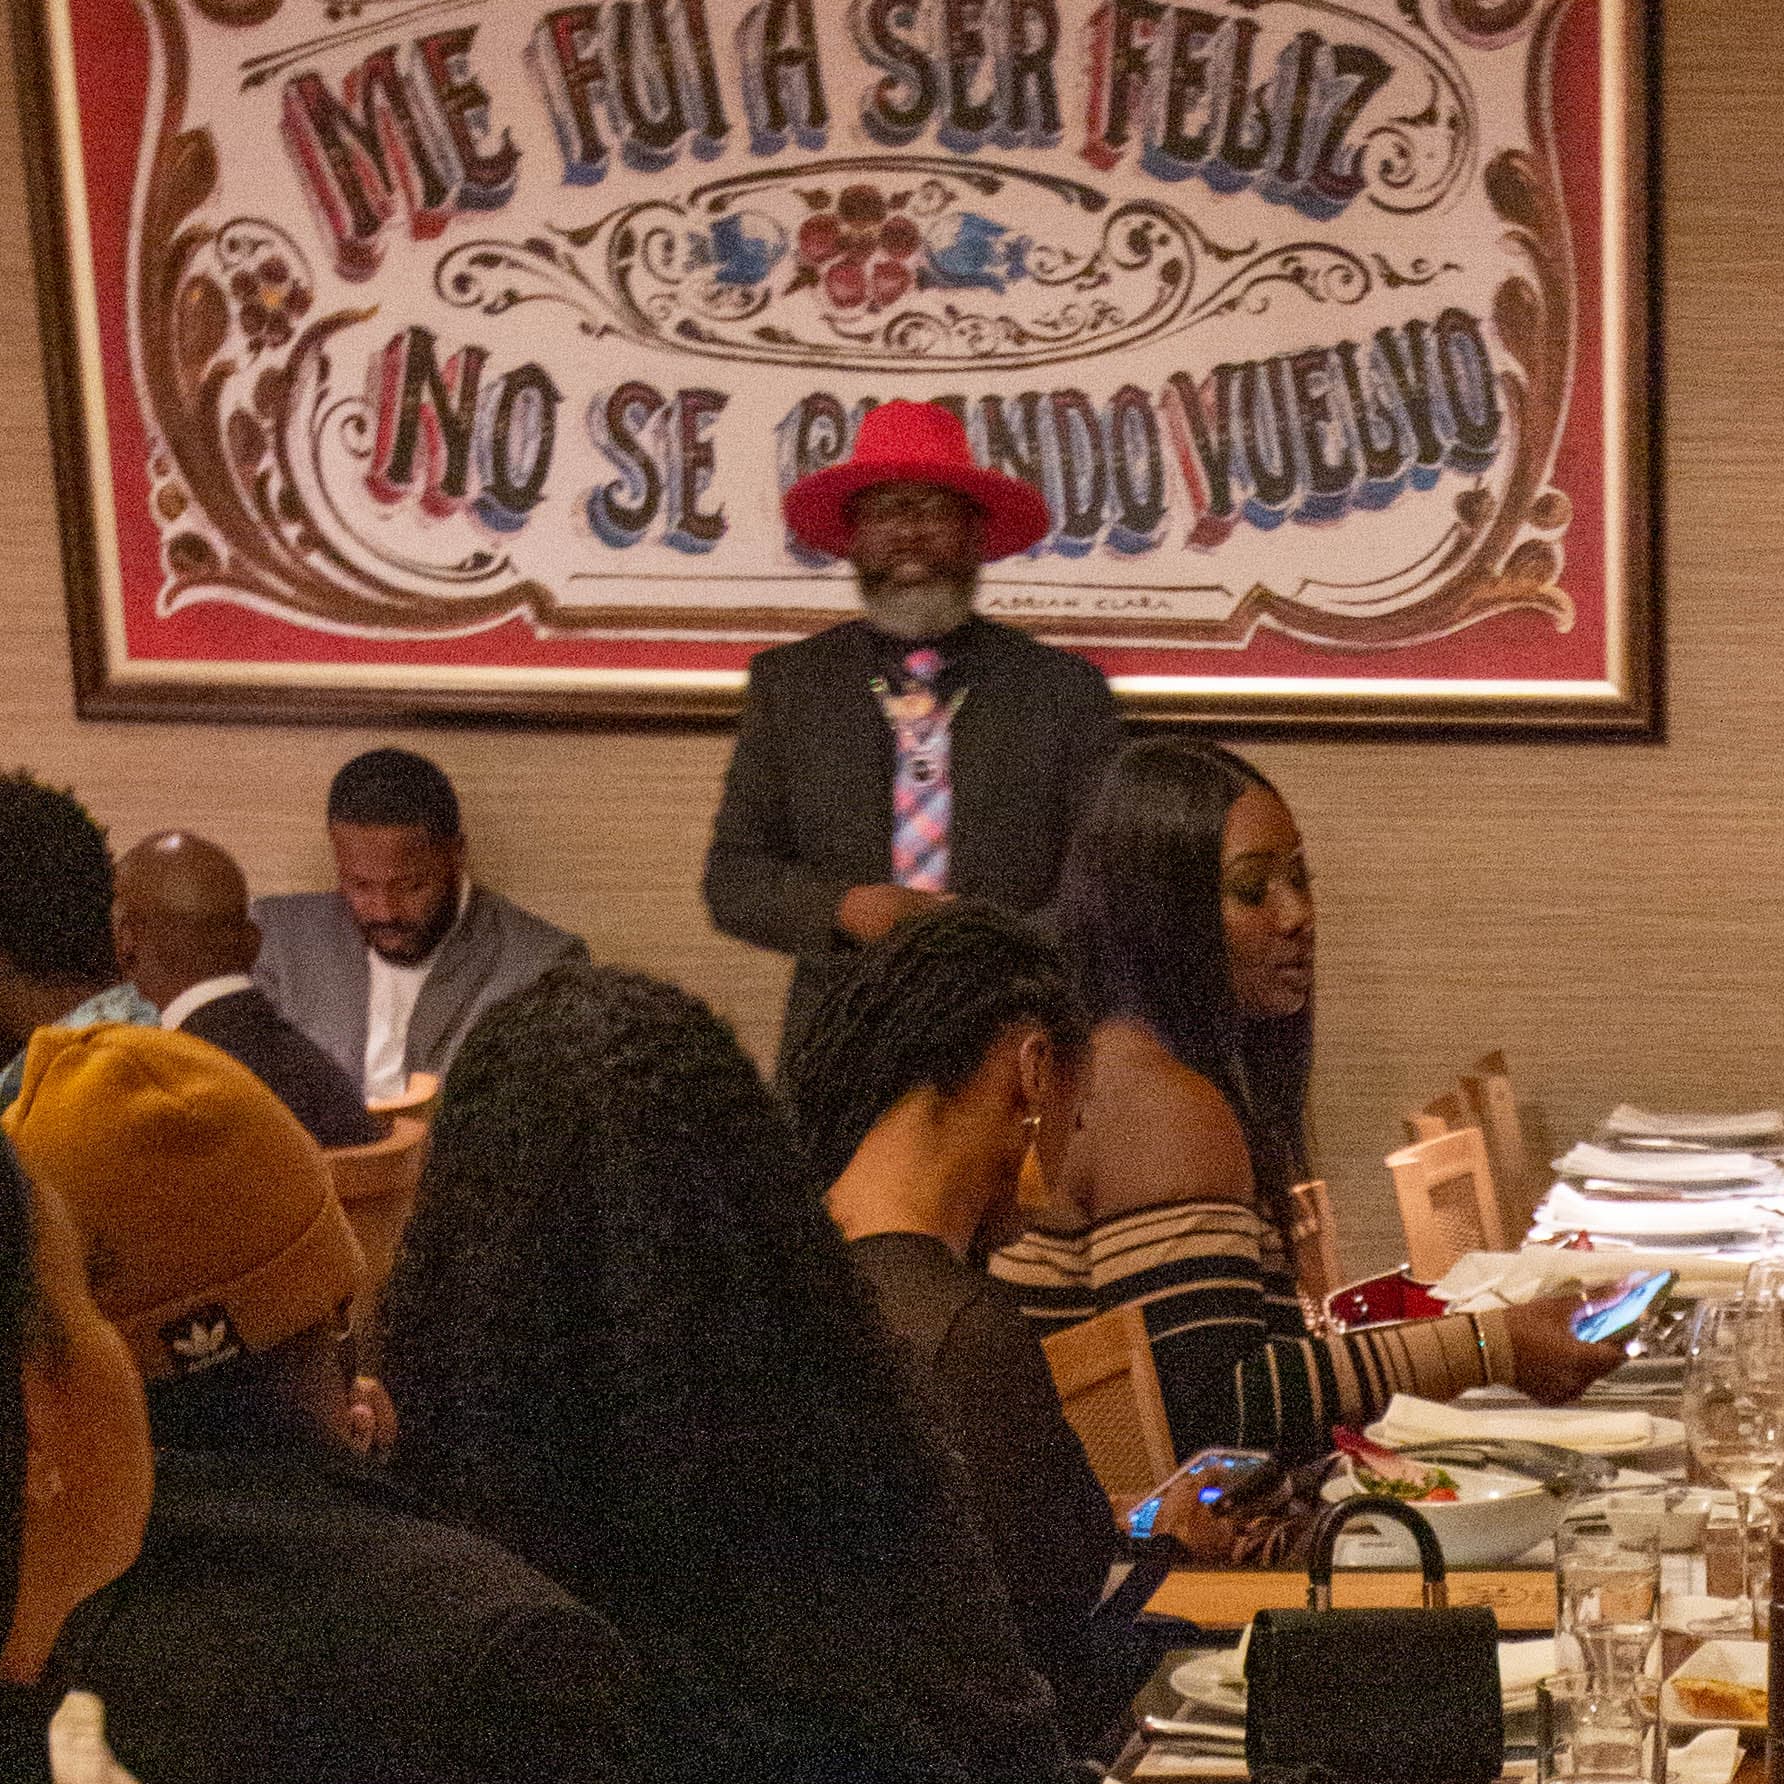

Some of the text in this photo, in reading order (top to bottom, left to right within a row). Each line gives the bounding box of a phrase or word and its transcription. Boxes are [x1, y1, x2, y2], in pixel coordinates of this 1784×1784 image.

[280, 0, 1396, 283] ME FUI A SER FELIZ
[363, 325, 566, 533] NO
[583, 378, 732, 555] SE
[1156, 306, 1502, 552] VUELVO
